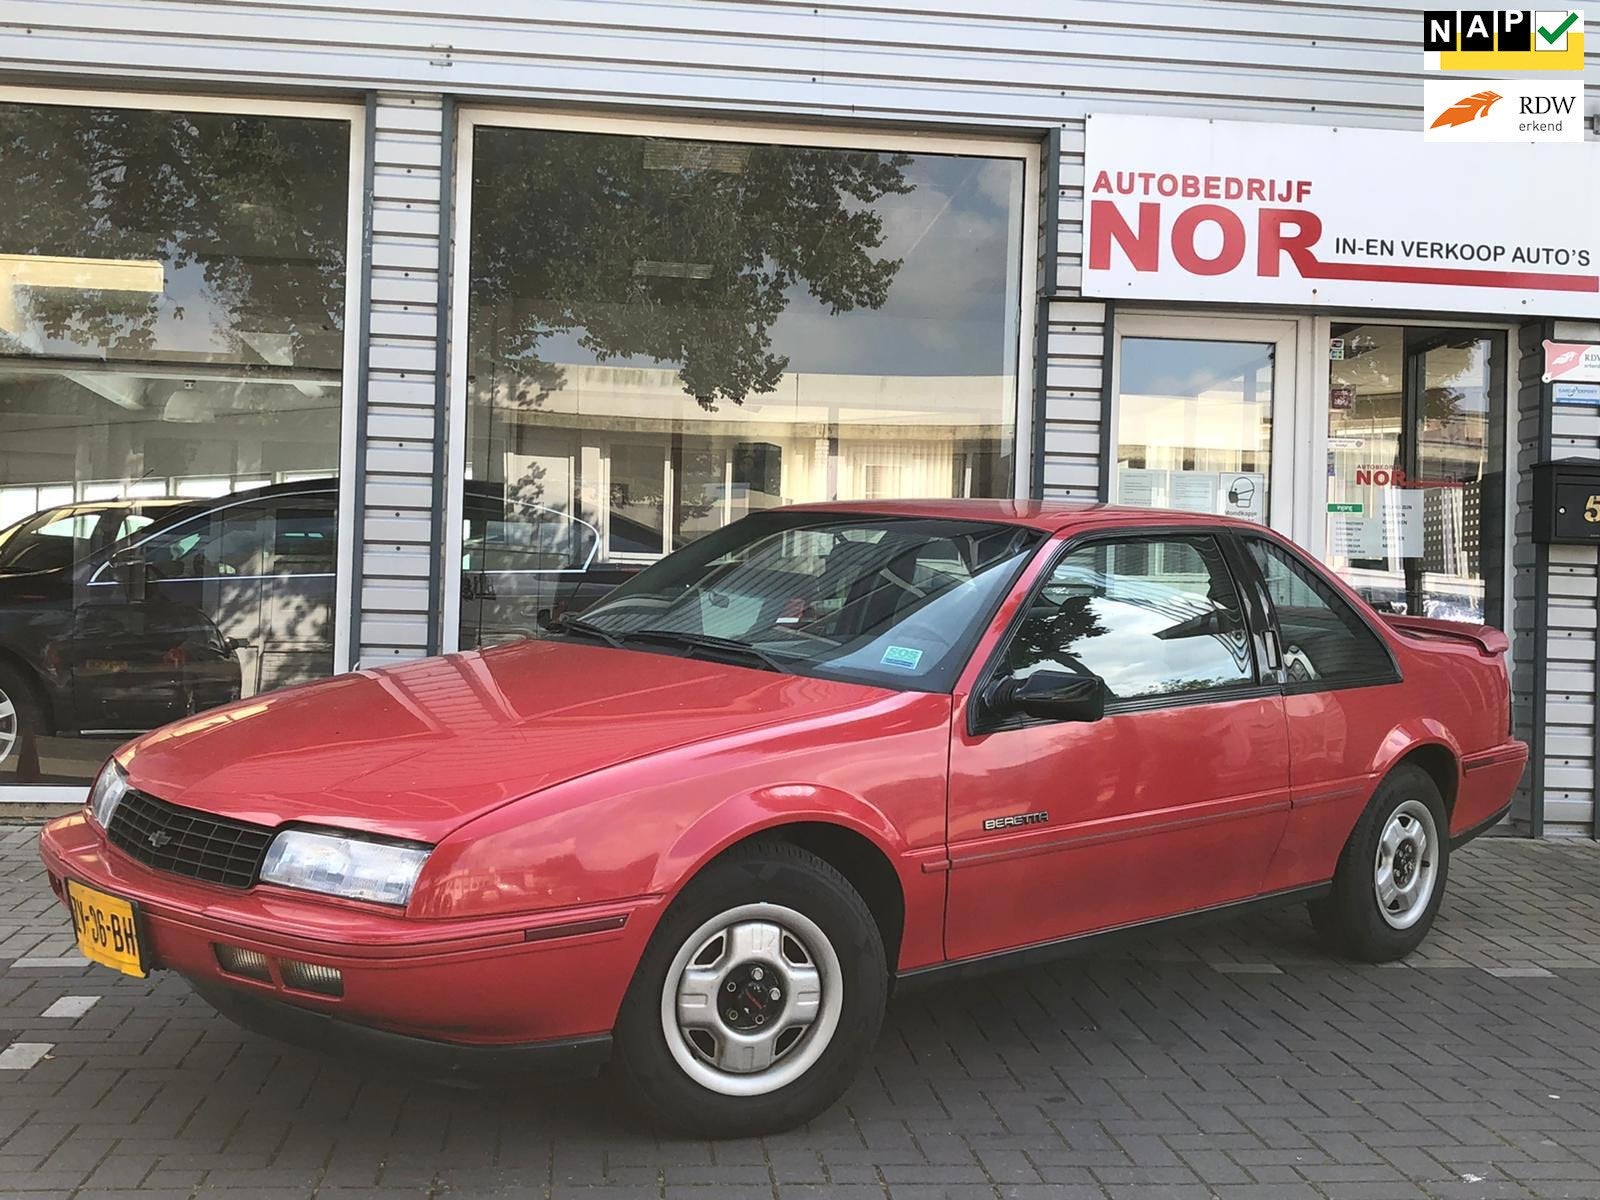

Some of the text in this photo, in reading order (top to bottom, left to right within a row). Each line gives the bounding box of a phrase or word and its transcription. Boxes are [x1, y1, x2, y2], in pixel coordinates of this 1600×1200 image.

[1091, 170, 1313, 203] AUTOBEDRIJF
[1089, 200, 1323, 279] NOR
[1335, 237, 1591, 267] IN-EN VERKOOP AUTO'S
[1356, 470, 1407, 486] NOR
[984, 811, 1049, 830] BERETTA
